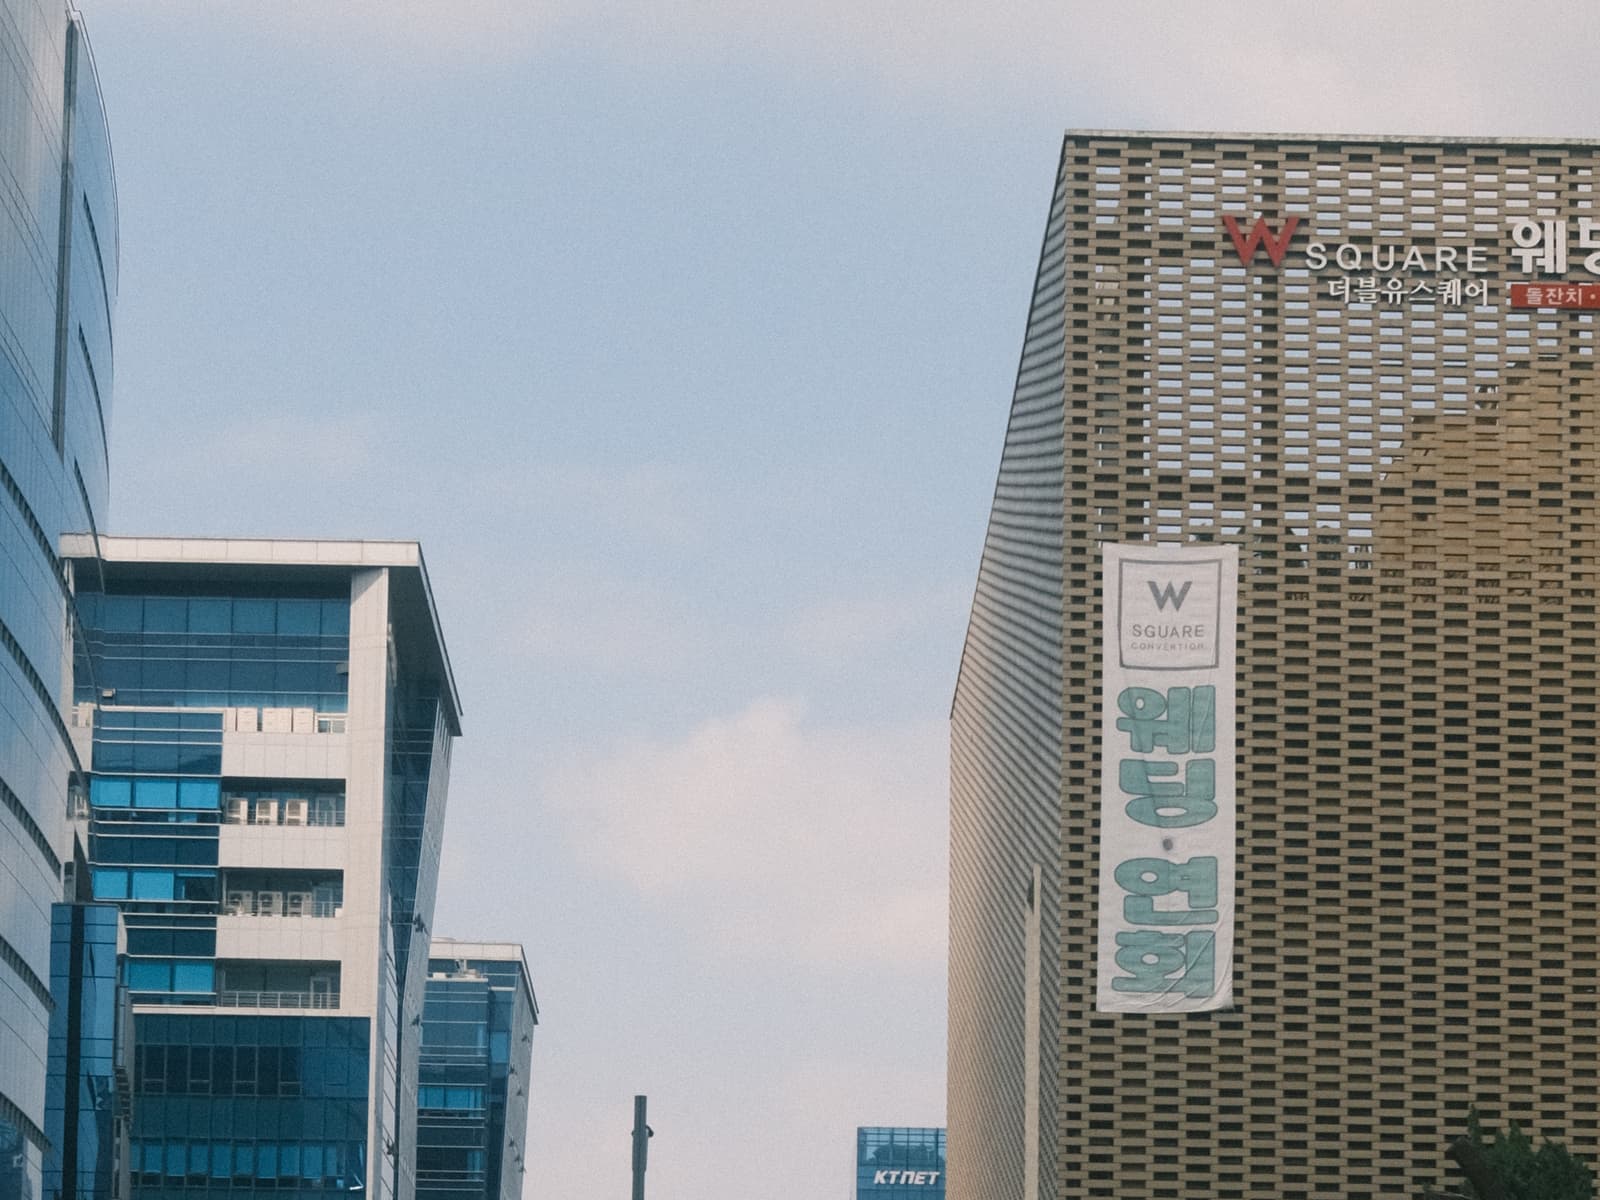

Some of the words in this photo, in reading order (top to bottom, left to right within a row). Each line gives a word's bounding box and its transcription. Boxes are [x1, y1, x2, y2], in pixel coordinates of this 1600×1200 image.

[1222, 214, 1300, 268] W
[1305, 243, 1489, 272] SQUARE
[1327, 276, 1489, 307] 더블유스퀘어
[1146, 580, 1193, 613] W
[873, 1170, 940, 1185] KTNET
